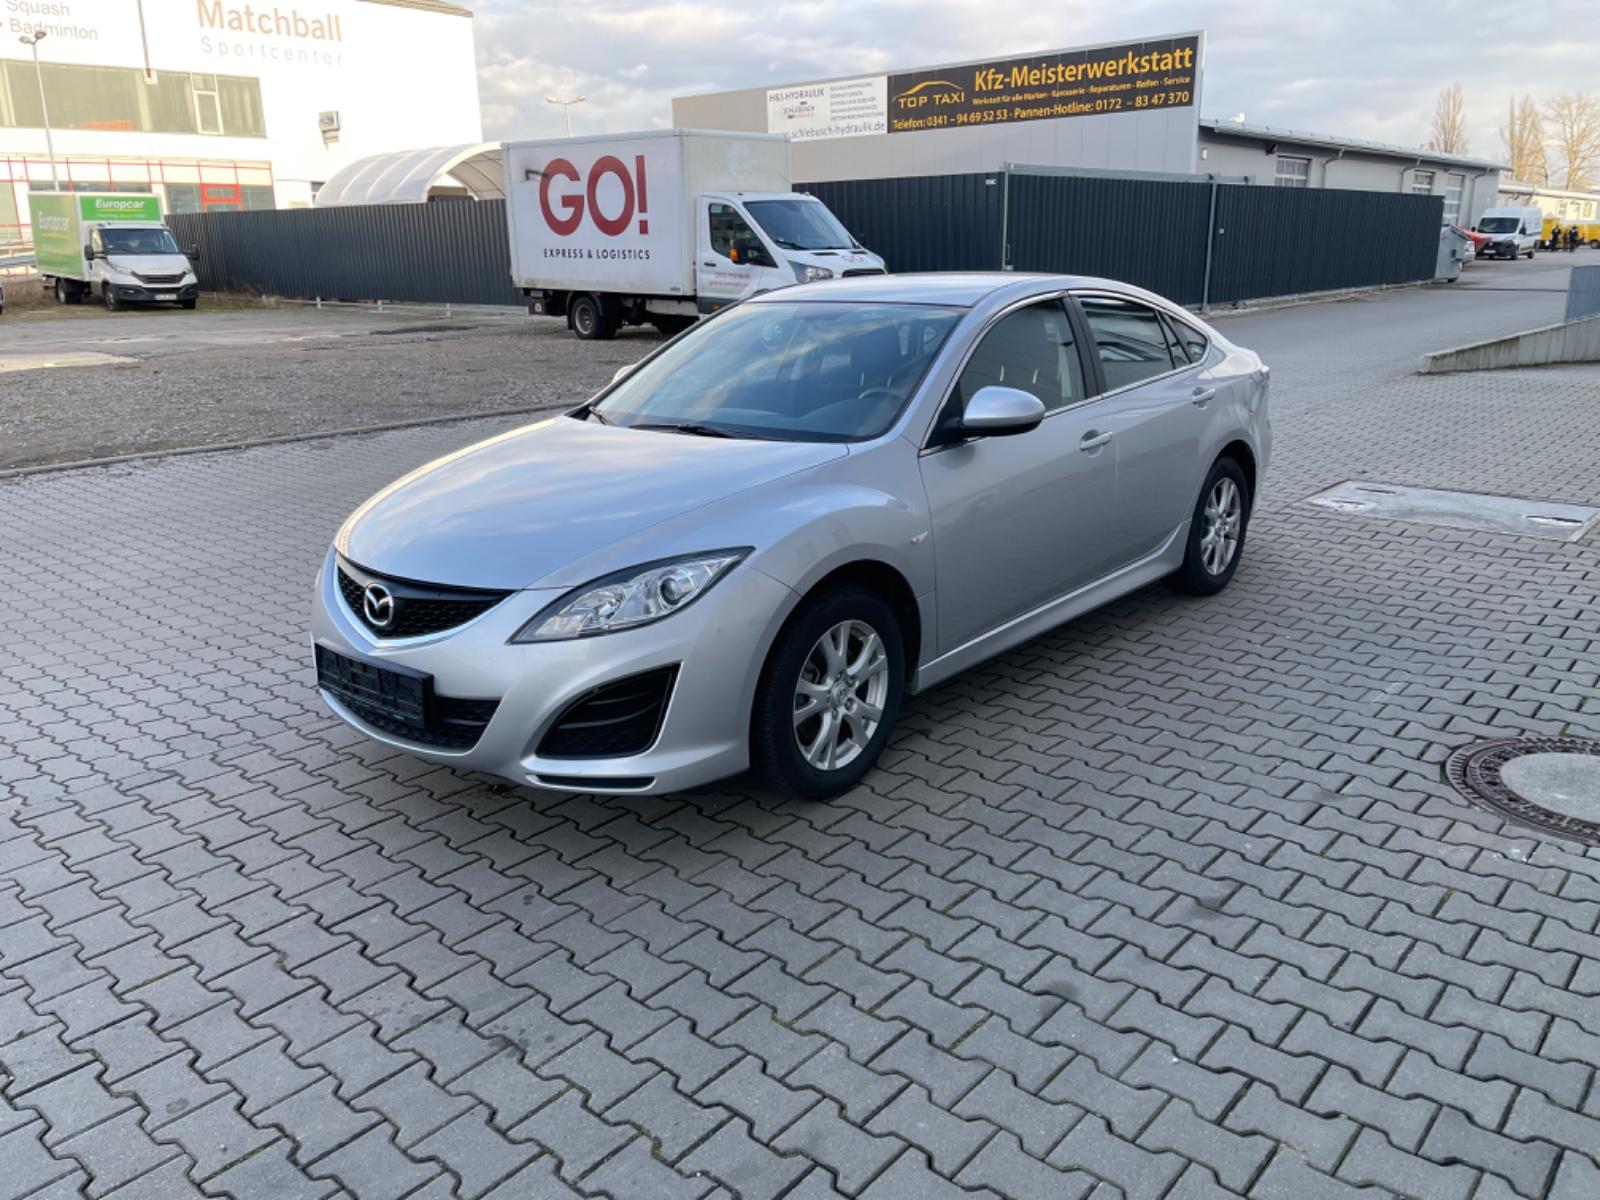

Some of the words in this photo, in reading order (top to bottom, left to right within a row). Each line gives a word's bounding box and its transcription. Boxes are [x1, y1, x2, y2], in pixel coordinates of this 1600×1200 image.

[6, 0, 70, 16] Squash
[9, 17, 98, 40] Badminton
[196, 0, 342, 42] Matchball
[200, 35, 343, 66] Sportcenter
[974, 47, 1193, 92] Kfz-Meisterwerkstatt
[1136, 79, 1159, 89] Reifen
[1163, 76, 1191, 86] Service
[892, 116, 926, 129] Telefon:
[927, 115, 948, 127] 0341
[957, 113, 968, 124] 94
[969, 112, 981, 123] 69
[983, 110, 994, 121] 52
[996, 109, 1007, 120] 53
[1014, 100, 1094, 119] Pannen-Hotline:
[1095, 98, 1122, 111] 0172
[1135, 95, 1149, 107] 83
[1151, 93, 1166, 105] 47
[1168, 91, 1190, 104] 370
[898, 95, 928, 109] TOP
[933, 92, 965, 105] TAXI
[95, 198, 145, 210] Europcar
[539, 154, 649, 237] GO!
[543, 248, 584, 259] EXPRESS
[587, 249, 593, 259] &
[596, 249, 650, 260] LOGISTICS
